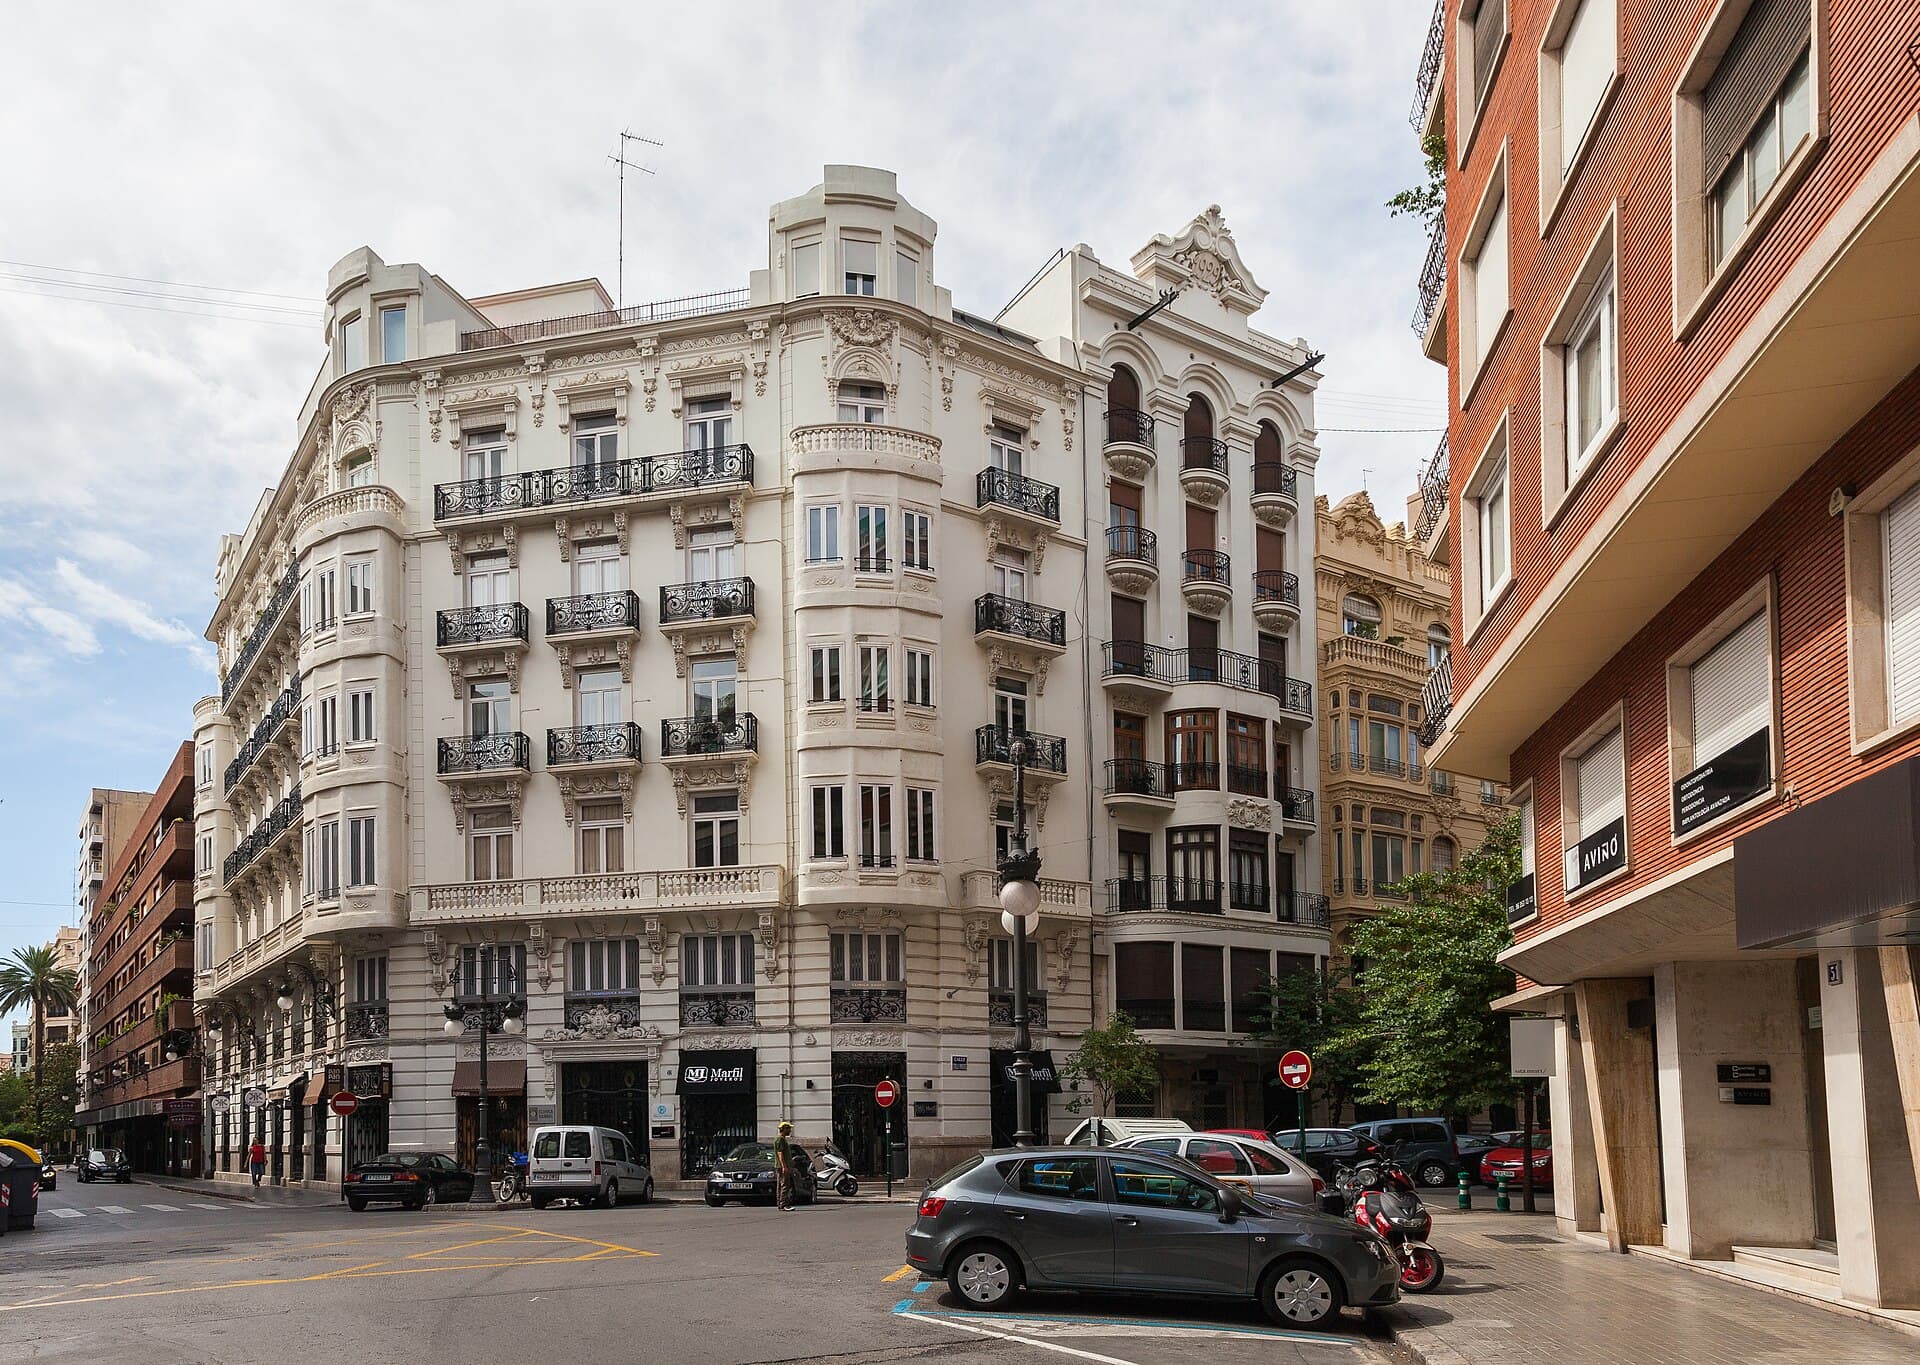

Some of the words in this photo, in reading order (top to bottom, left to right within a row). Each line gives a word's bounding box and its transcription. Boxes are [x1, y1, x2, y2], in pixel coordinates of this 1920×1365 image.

[1681, 785, 1704, 802] ORTODONCIA
[1584, 833, 1618, 872] AVIÑÓ
[1830, 966, 1839, 981] 51
[710, 1067, 744, 1078] Marfil
